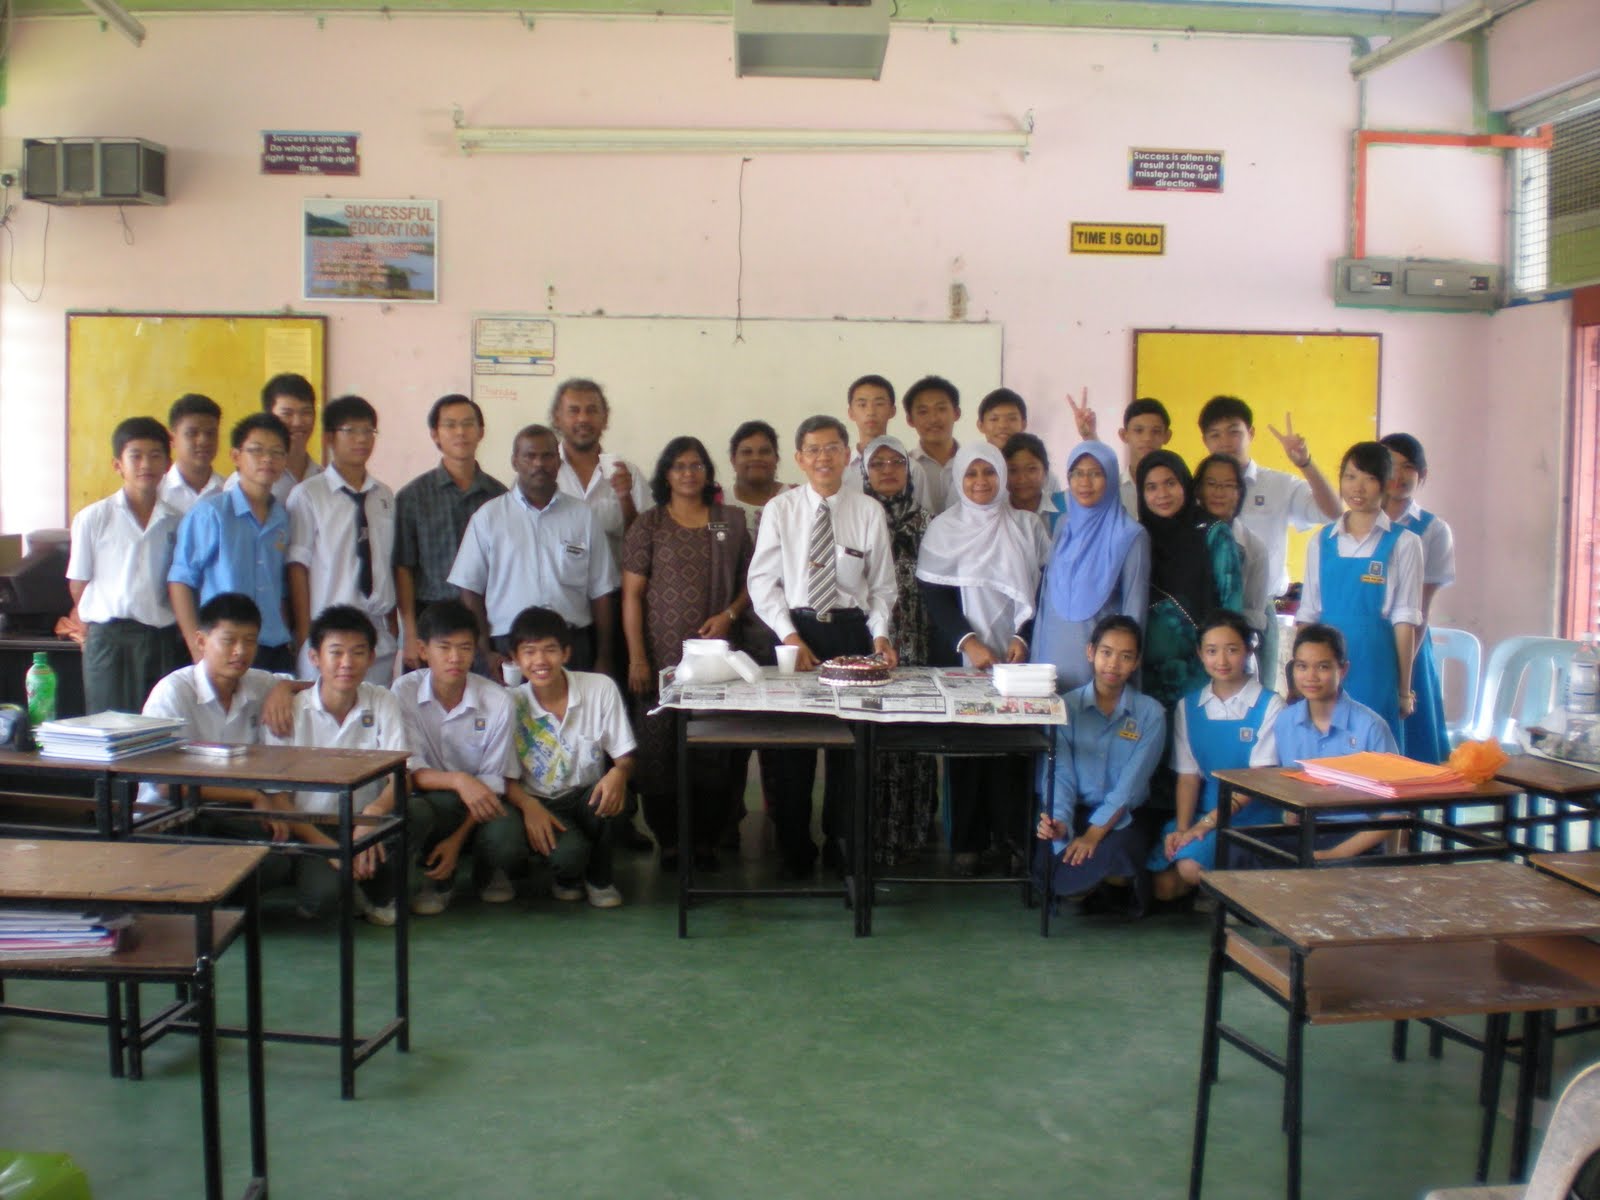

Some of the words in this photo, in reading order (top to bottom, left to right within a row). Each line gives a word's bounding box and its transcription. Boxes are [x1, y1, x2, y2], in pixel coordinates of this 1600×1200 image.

[270, 144, 282, 152] Do
[284, 144, 311, 152] what's
[336, 145, 351, 153] the
[265, 154, 285, 163] right
[335, 155, 355, 164] right
[1134, 152, 1170, 160] Success
[1180, 153, 1204, 161] often
[1205, 154, 1220, 162] the
[1176, 162, 1204, 171] taking
[1135, 169, 1169, 179] misstep
[1171, 170, 1179, 178] in
[1181, 171, 1195, 179] the
[1197, 172, 1217, 181] right
[1155, 179, 1197, 188] direction.
[344, 204, 435, 221] SUCCESSFUL
[350, 221, 429, 236] EDUCATION
[1076, 231, 1106, 244] TIME
[1110, 232, 1122, 245] IS
[1125, 232, 1159, 246] GOLD
